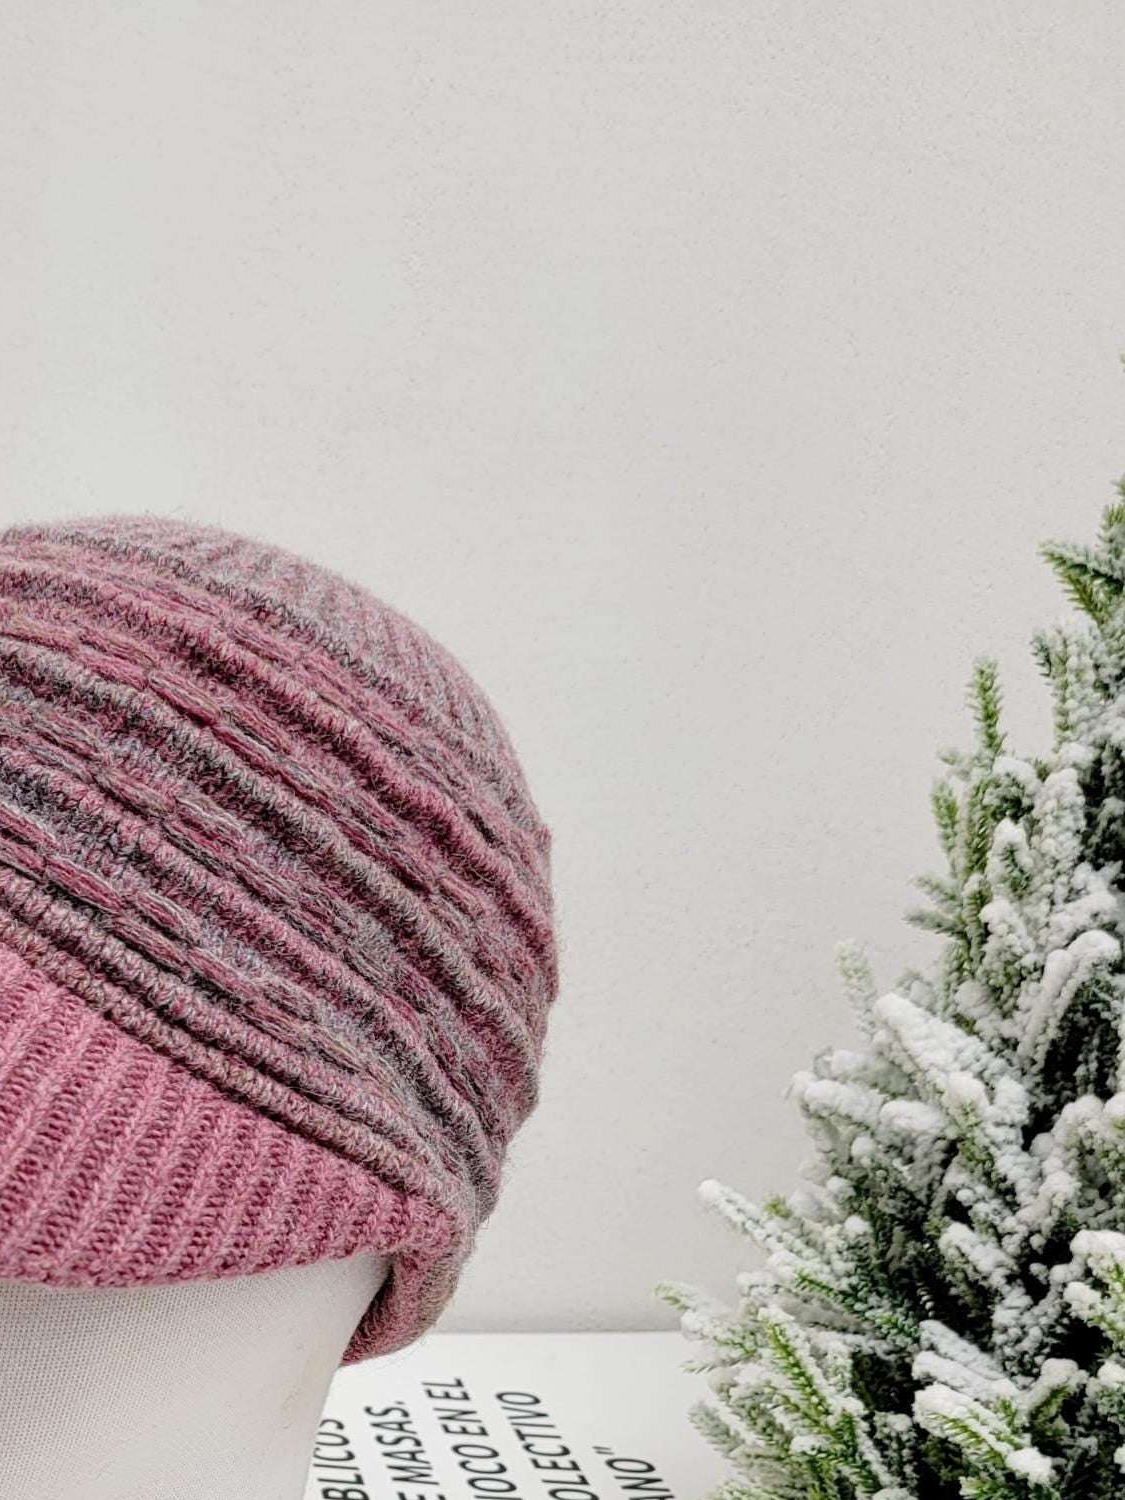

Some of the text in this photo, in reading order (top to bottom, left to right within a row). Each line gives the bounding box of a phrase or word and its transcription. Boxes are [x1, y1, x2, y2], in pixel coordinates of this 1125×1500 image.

[422, 1378, 472, 1401] EL
[433, 1407, 489, 1437] EN
[364, 1401, 440, 1485] MASAS.
